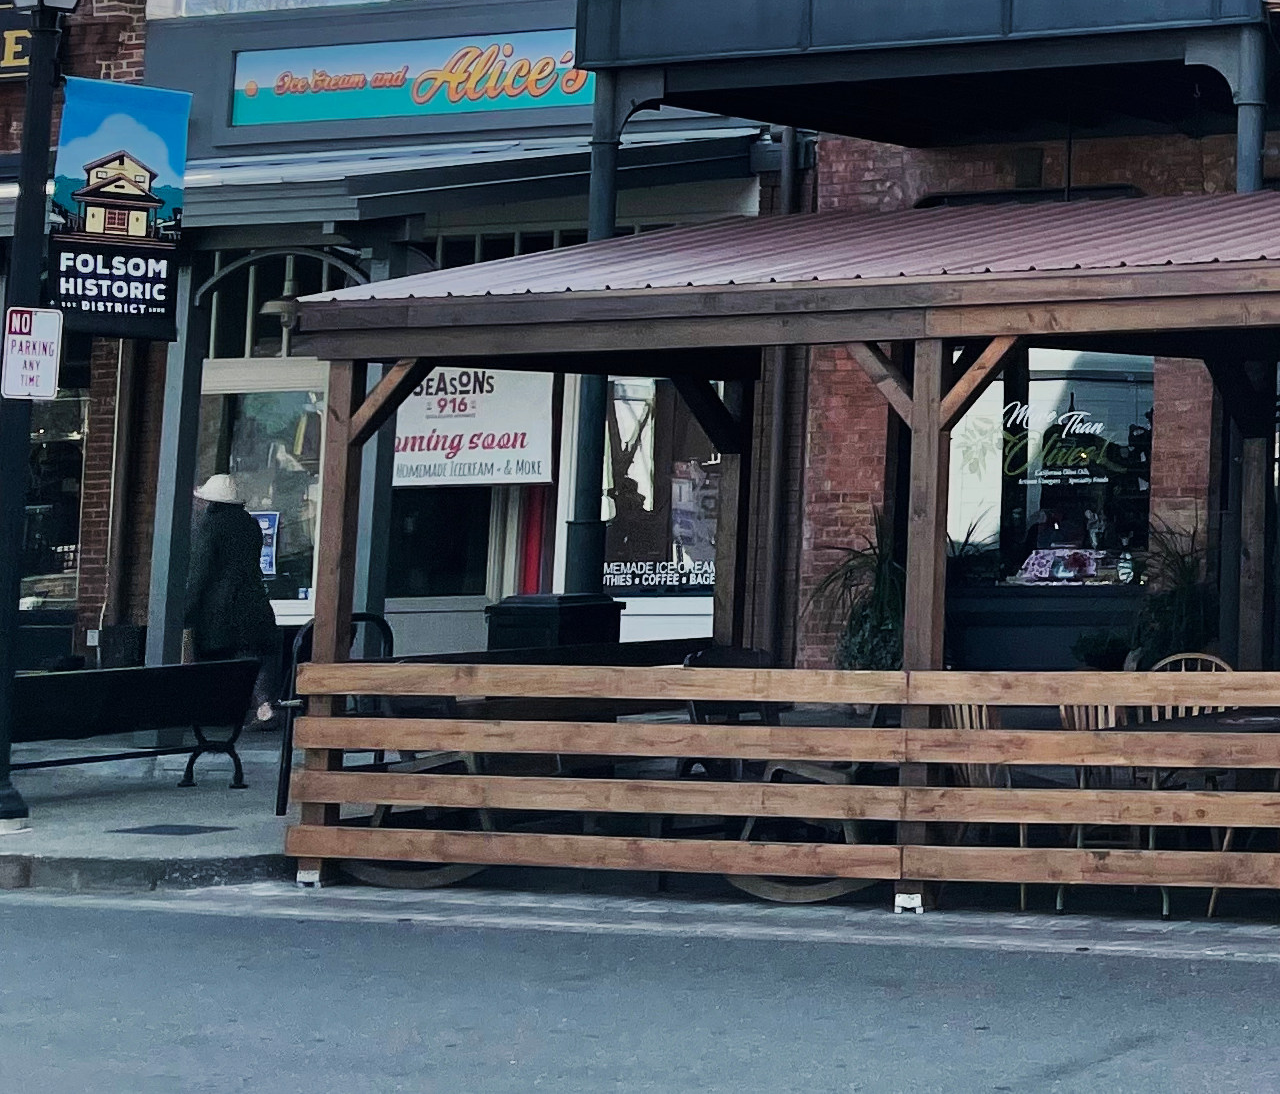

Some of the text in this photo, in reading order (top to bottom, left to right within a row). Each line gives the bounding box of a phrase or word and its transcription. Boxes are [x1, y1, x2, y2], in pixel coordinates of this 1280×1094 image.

[275, 43, 588, 105] Ice Cream and Alice's
[60, 252, 168, 278] FOLSOM
[60, 277, 166, 301] HISTORIC
[81, 301, 146, 314] DISTRICT
[11, 313, 31, 333] NO
[11, 340, 54, 356] PARKING
[23, 360, 40, 371] ANY
[21, 375, 40, 388] TIME
[437, 397, 467, 413] 916
[1057, 410, 1106, 438] Than
[469, 431, 527, 450] soon
[655, 562, 676, 573] ICE
[642, 574, 679, 585] COFFEE
